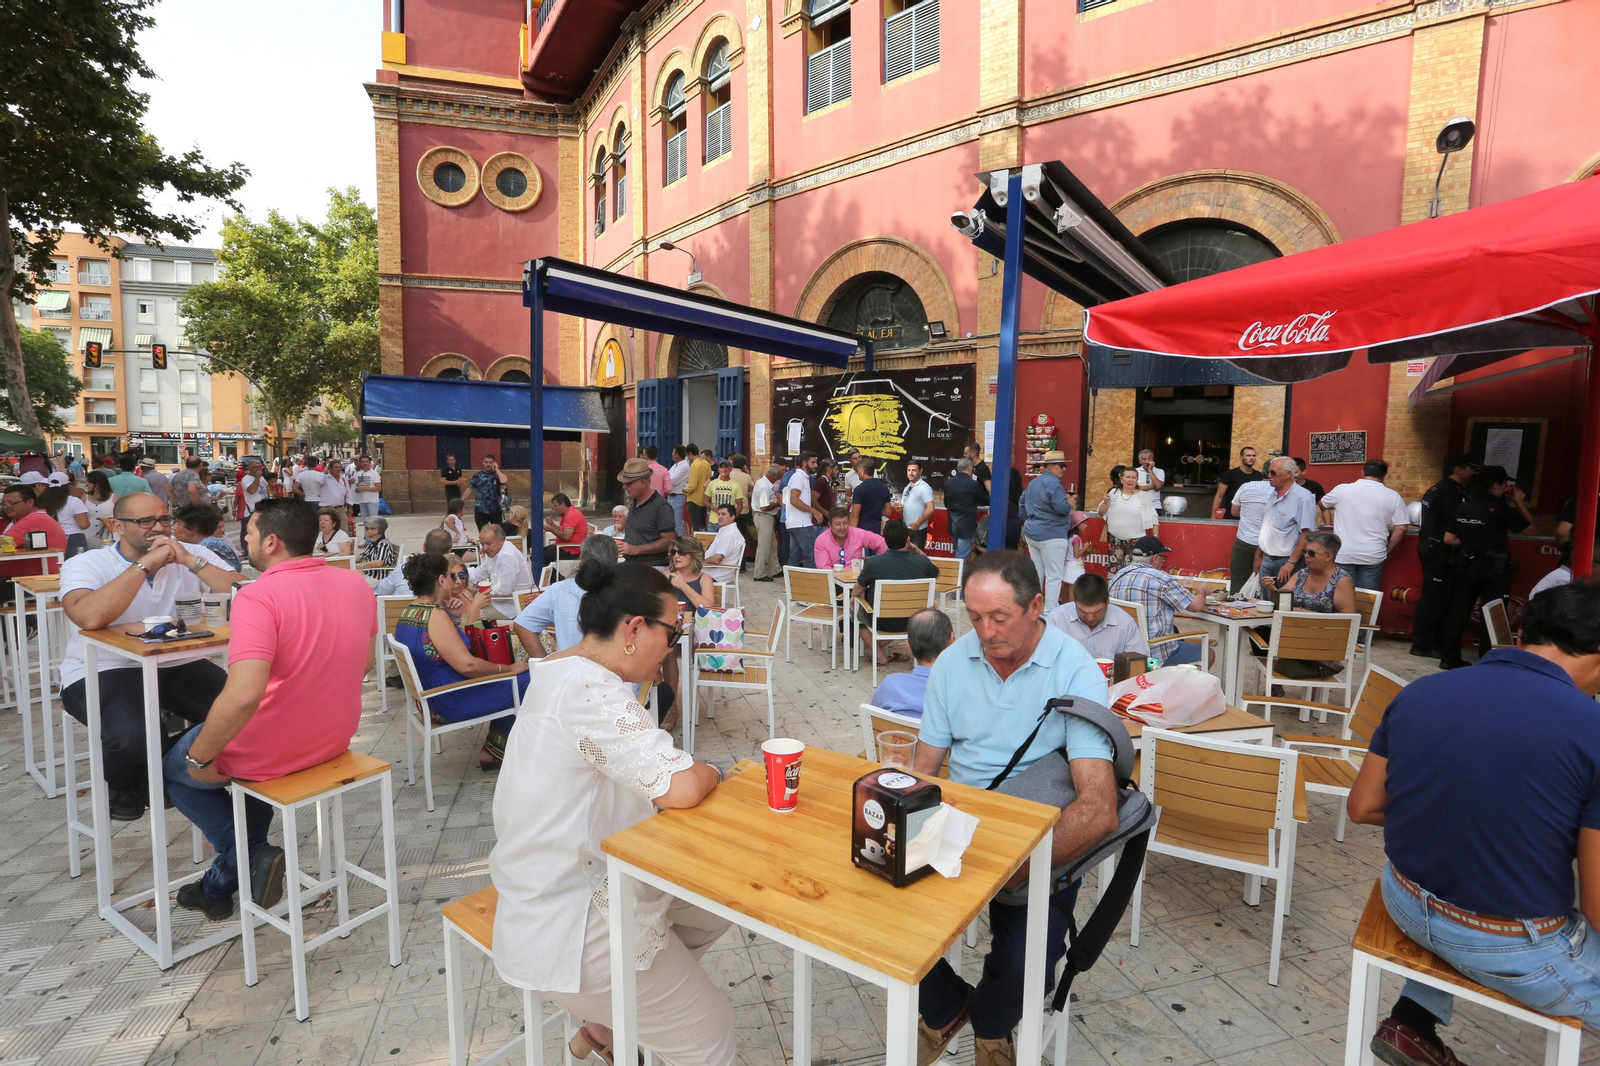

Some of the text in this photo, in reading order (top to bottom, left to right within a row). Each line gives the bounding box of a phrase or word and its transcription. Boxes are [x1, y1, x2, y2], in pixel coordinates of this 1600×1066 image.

[1238, 309, 1338, 351] Coca-Cola
[1311, 432, 1363, 442] PONCHE
[1456, 517, 1483, 525] POLICIA
[864, 807, 884, 822] BAZAR
